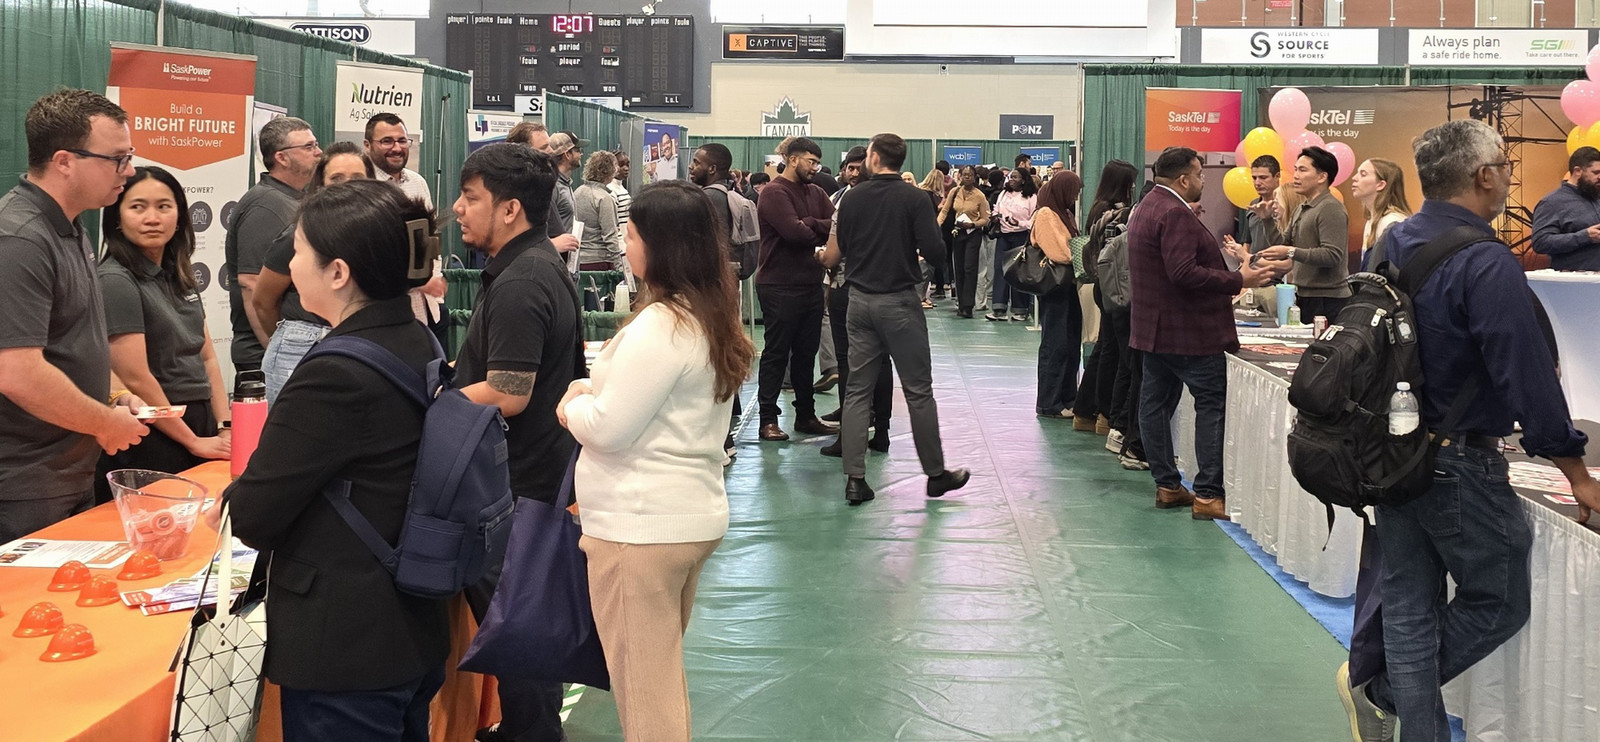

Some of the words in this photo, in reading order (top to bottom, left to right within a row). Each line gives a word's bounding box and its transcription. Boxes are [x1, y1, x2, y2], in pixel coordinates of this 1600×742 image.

[448, 15, 466, 24] player
[475, 16, 494, 24] points
[497, 16, 512, 24] fouls
[520, 17, 538, 25] Home
[553, 16, 593, 32] 12:07
[598, 18, 621, 26] Guests
[626, 17, 645, 26] player
[559, 43, 580, 52] period
[750, 38, 793, 47] CAPTIVE
[1278, 41, 1329, 50] SOURCE
[1423, 35, 1469, 50] Always
[1473, 35, 1500, 50] plan
[1530, 40, 1563, 50] SGI
[1430, 50, 1450, 59] safe
[1452, 50, 1470, 59] ride
[1473, 50, 1502, 59] home.
[559, 57, 580, 66] player
[170, 63, 212, 76] SaskPower
[351, 82, 412, 106] Nutrien
[170, 103, 193, 114] Build
[350, 108, 360, 122] Ag
[1168, 110, 1206, 123] SaskTel
[1309, 110, 1351, 124] skTel
[134, 116, 184, 132] BRIGHT
[189, 119, 236, 134] FUTURE
[1168, 124, 1184, 132] Today
[1200, 126, 1211, 134] day
[1318, 128, 1325, 137] is
[1327, 128, 1342, 137] the
[1343, 128, 1360, 139] day
[148, 136, 168, 146] with
[171, 136, 223, 148] SaskPower
